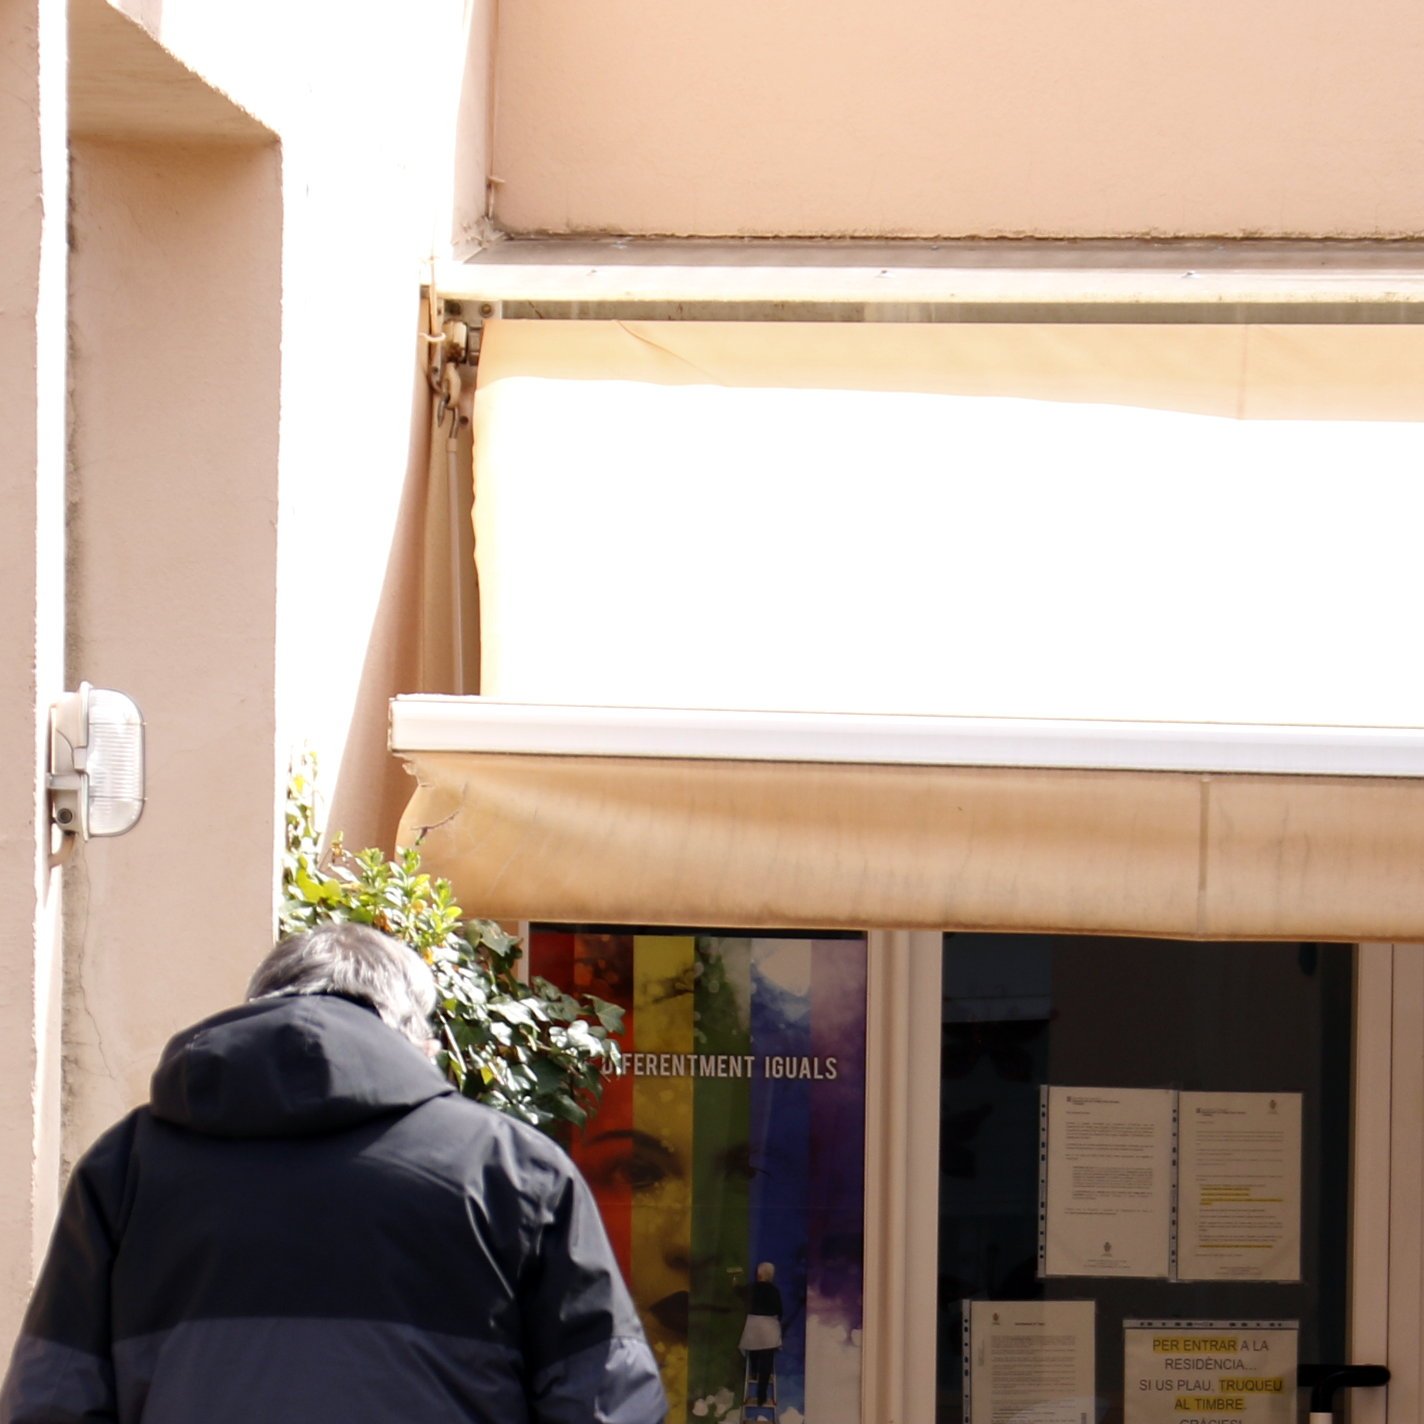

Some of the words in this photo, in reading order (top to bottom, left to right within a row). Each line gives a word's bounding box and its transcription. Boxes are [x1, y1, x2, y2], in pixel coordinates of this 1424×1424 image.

[602, 1053, 755, 1078] DFERENTMENT
[765, 1056, 838, 1079] IGUALS
[1153, 1339, 1179, 1351] PER
[1184, 1339, 1237, 1351] ENTRAR
[1240, 1340, 1249, 1351] A
[1253, 1340, 1269, 1351] LA
[1139, 1379, 1152, 1391] SI
[1155, 1379, 1173, 1391] US
[1177, 1379, 1215, 1392] PLAU,
[1219, 1379, 1282, 1392] TRUQUEU
[1174, 1398, 1190, 1410] AL
[1194, 1398, 1247, 1410] TIMBRE.
